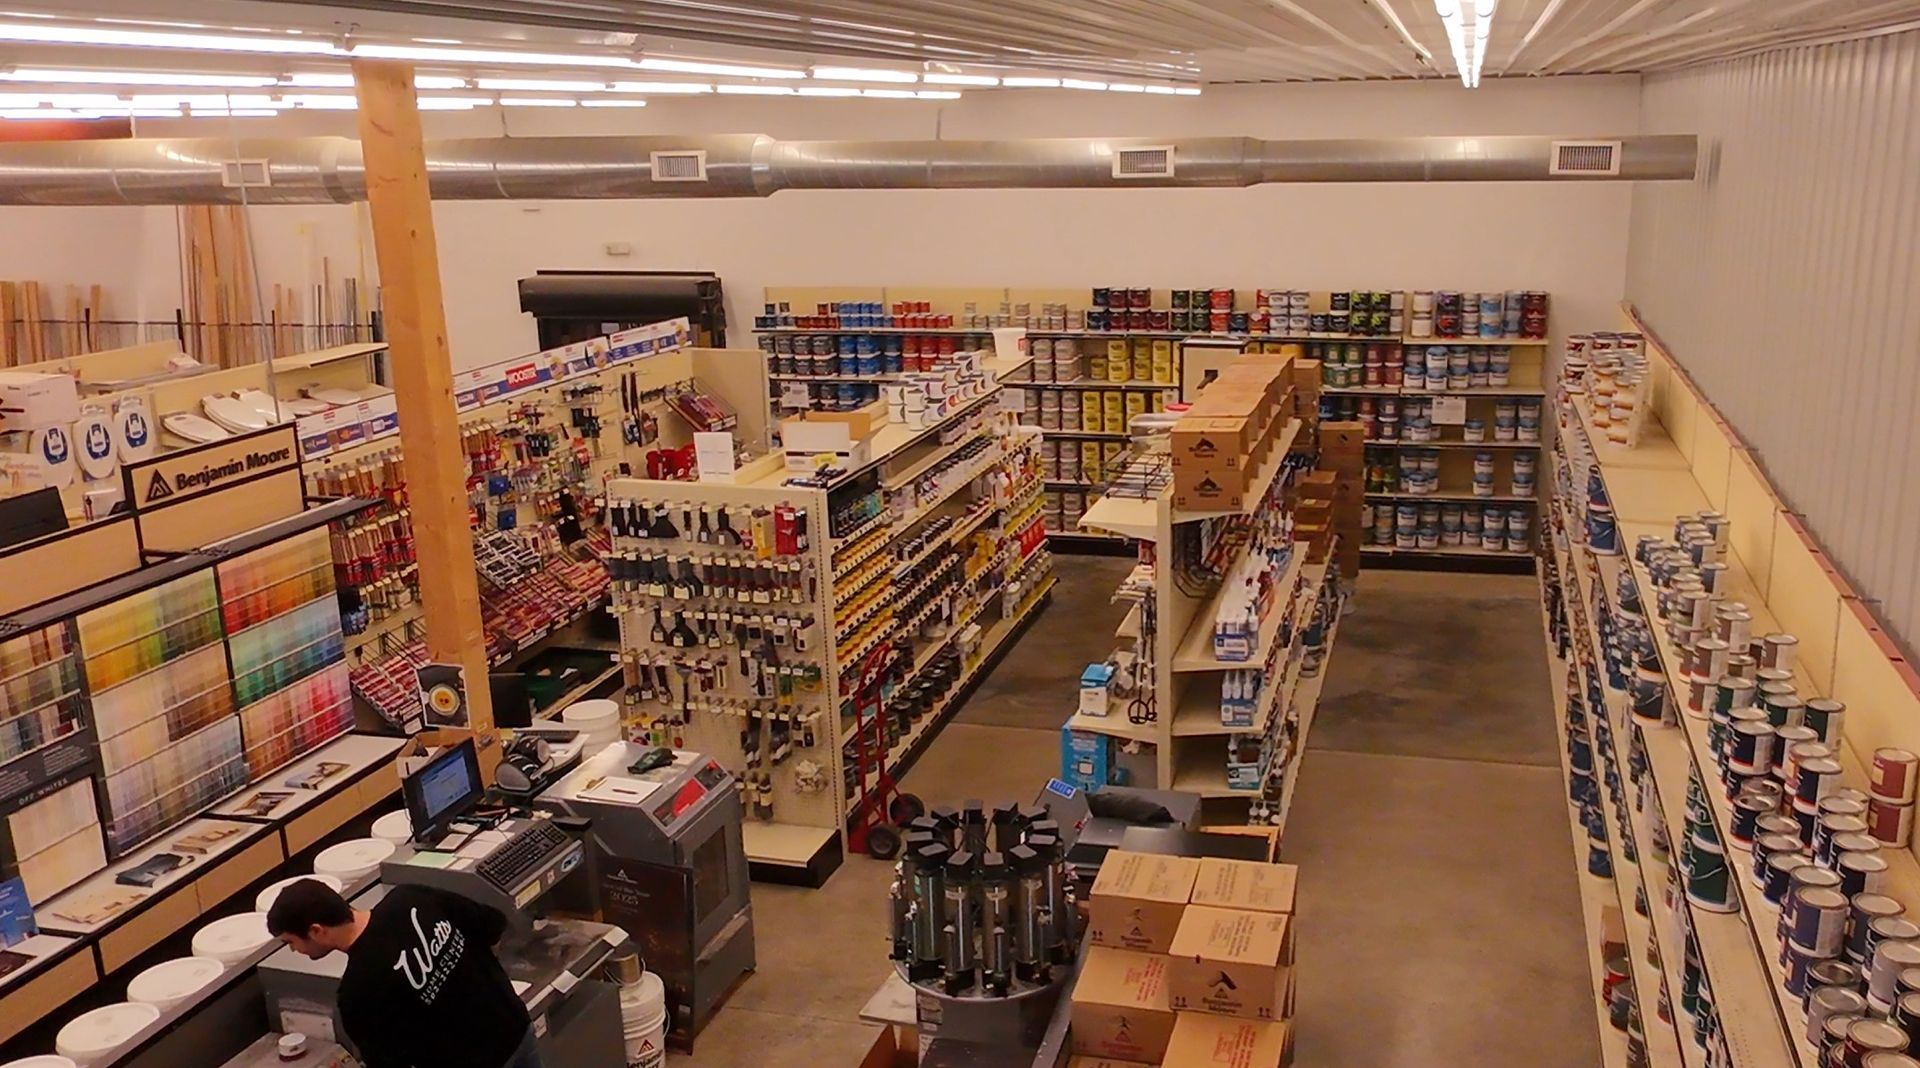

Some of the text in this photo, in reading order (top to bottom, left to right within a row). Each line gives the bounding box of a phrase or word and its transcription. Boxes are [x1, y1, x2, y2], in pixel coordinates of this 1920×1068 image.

[175, 447, 291, 491] Benjamin Moore
[393, 907, 452, 989] Watts
